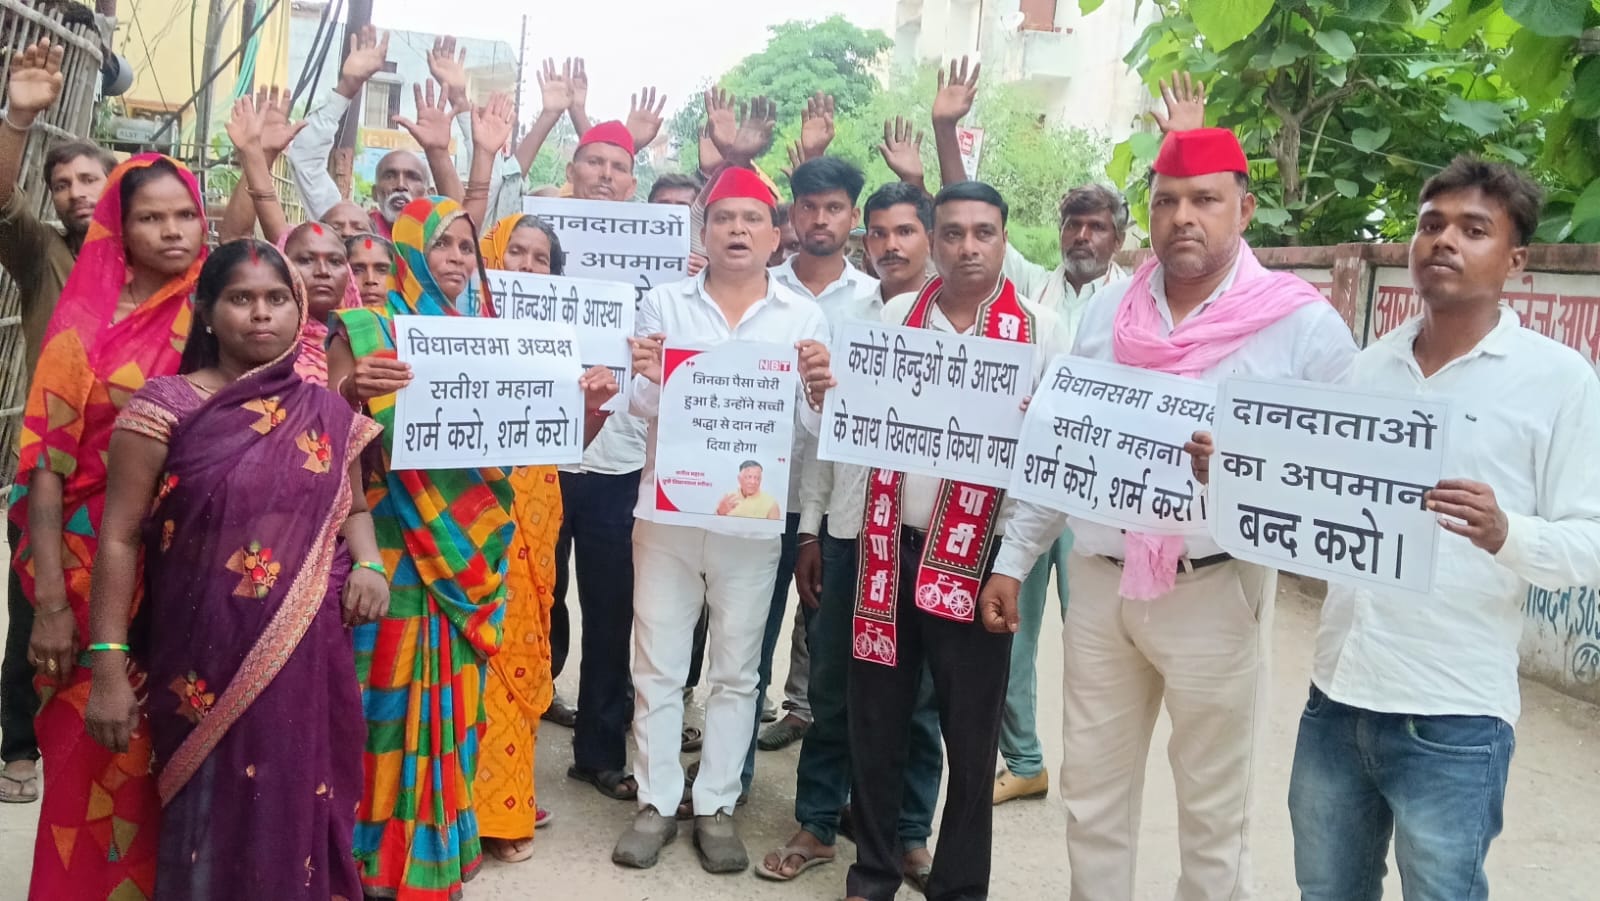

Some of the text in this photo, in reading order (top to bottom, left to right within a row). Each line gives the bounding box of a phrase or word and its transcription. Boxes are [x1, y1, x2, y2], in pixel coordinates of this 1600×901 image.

[580, 252, 685, 272] अपमान
[561, 286, 579, 325] की
[583, 300, 623, 329] आस्था
[408, 328, 573, 357] विधानसभा अध्यक्ष
[849, 330, 1019, 397] करोड़ों हिन्दुओं की आस्था
[430, 372, 554, 399] सतीश महाना
[693, 372, 780, 390] जिनका पैसा चोरी
[759, 359, 790, 372] NBT
[684, 395, 707, 410] हुआ
[723, 396, 754, 410] उन्होंने
[757, 399, 785, 412] सच्ची
[1051, 366, 1153, 410] विधानसभा
[405, 407, 442, 452] शर्म
[448, 409, 488, 455] करो,
[497, 406, 530, 448] शर्म
[692, 417, 776, 434] श्रद्धा से दान नहीं
[707, 437, 757, 454] दिया होगा
[833, 400, 1019, 470] के साथ खिलवाड़ किया गया
[1053, 414, 1185, 467] सतीश महाना
[1232, 398, 1438, 450] दानदाताओं
[1024, 445, 1062, 489] शर्म
[1063, 455, 1098, 509] करो,
[1109, 468, 1151, 514] शर्म
[1221, 451, 1436, 511] का अपमान
[1237, 502, 1302, 559] बन्द
